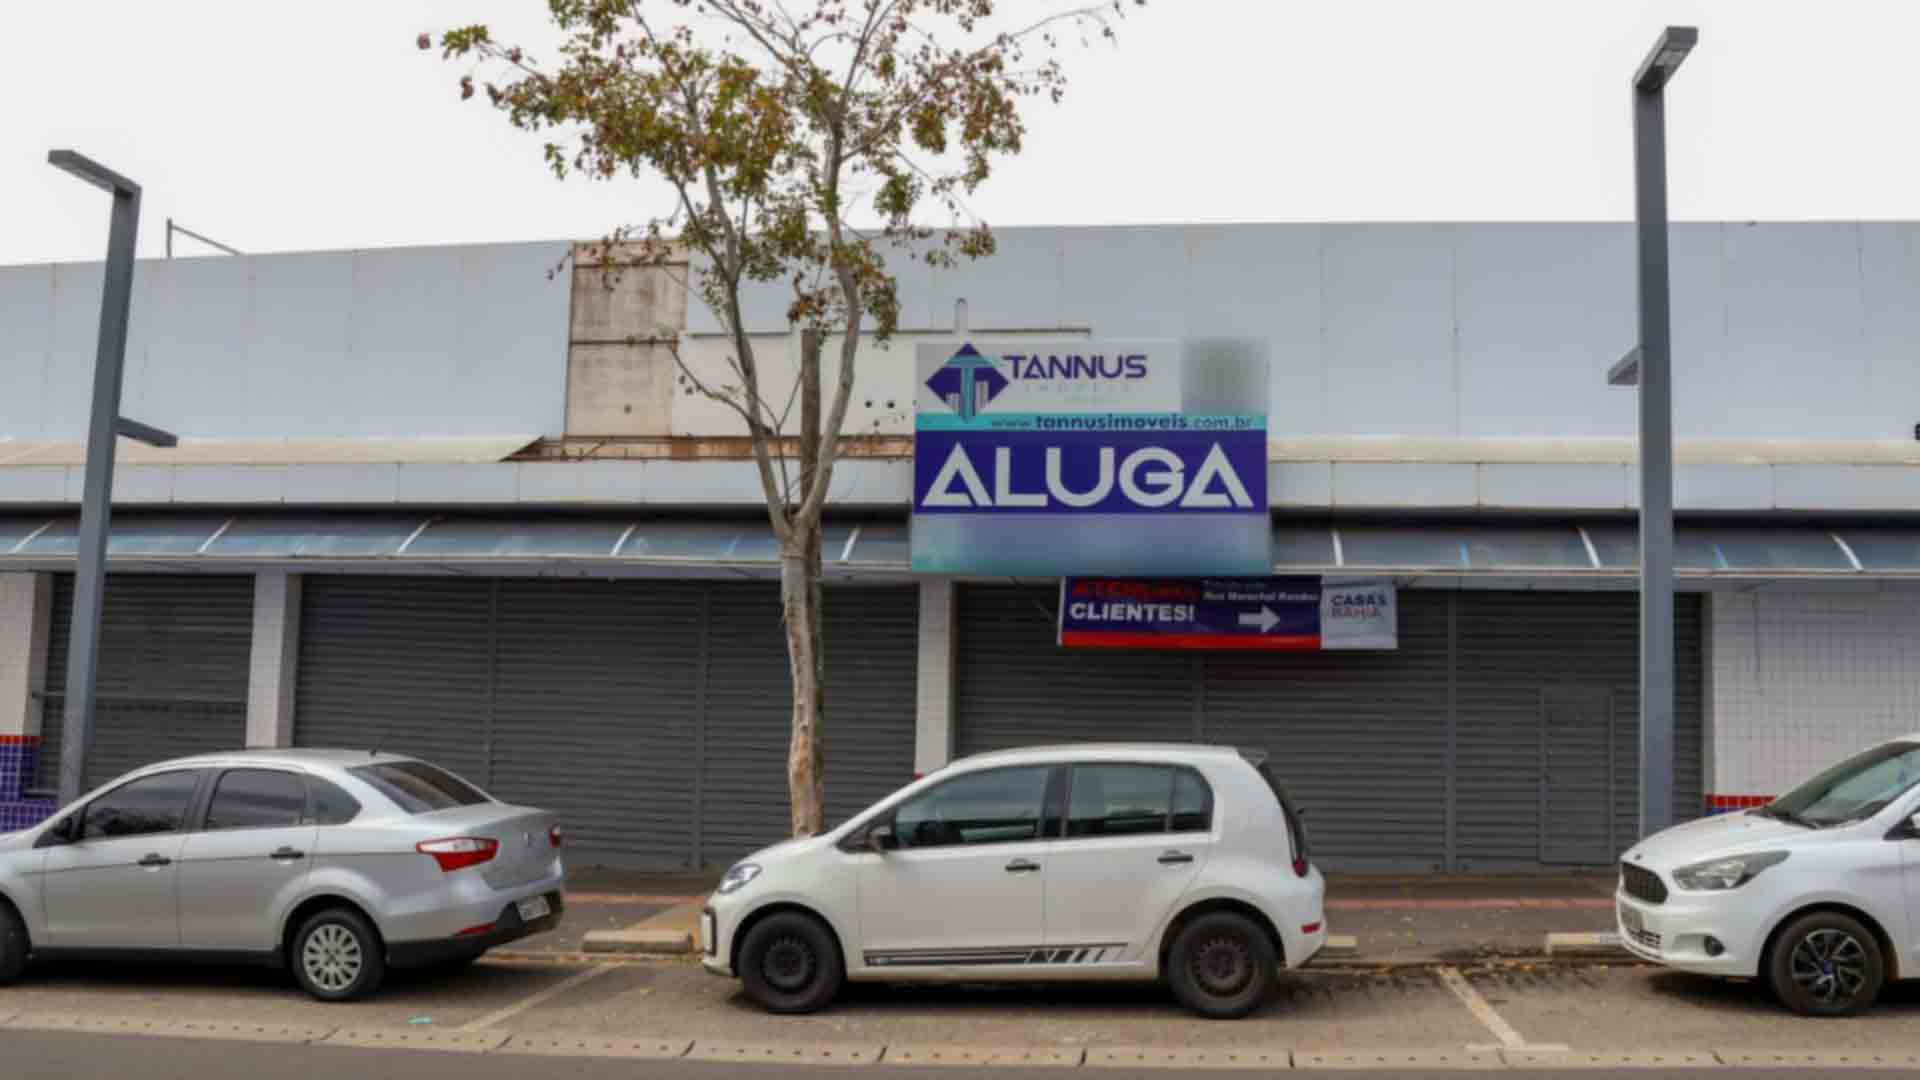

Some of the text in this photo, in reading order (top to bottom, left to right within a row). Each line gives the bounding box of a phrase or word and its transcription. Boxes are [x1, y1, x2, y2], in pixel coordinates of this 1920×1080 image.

[1002, 354, 1147, 380] TANNUS
[921, 441, 1255, 508] ALUGA
[1069, 602, 1196, 622] CLIENTES!
